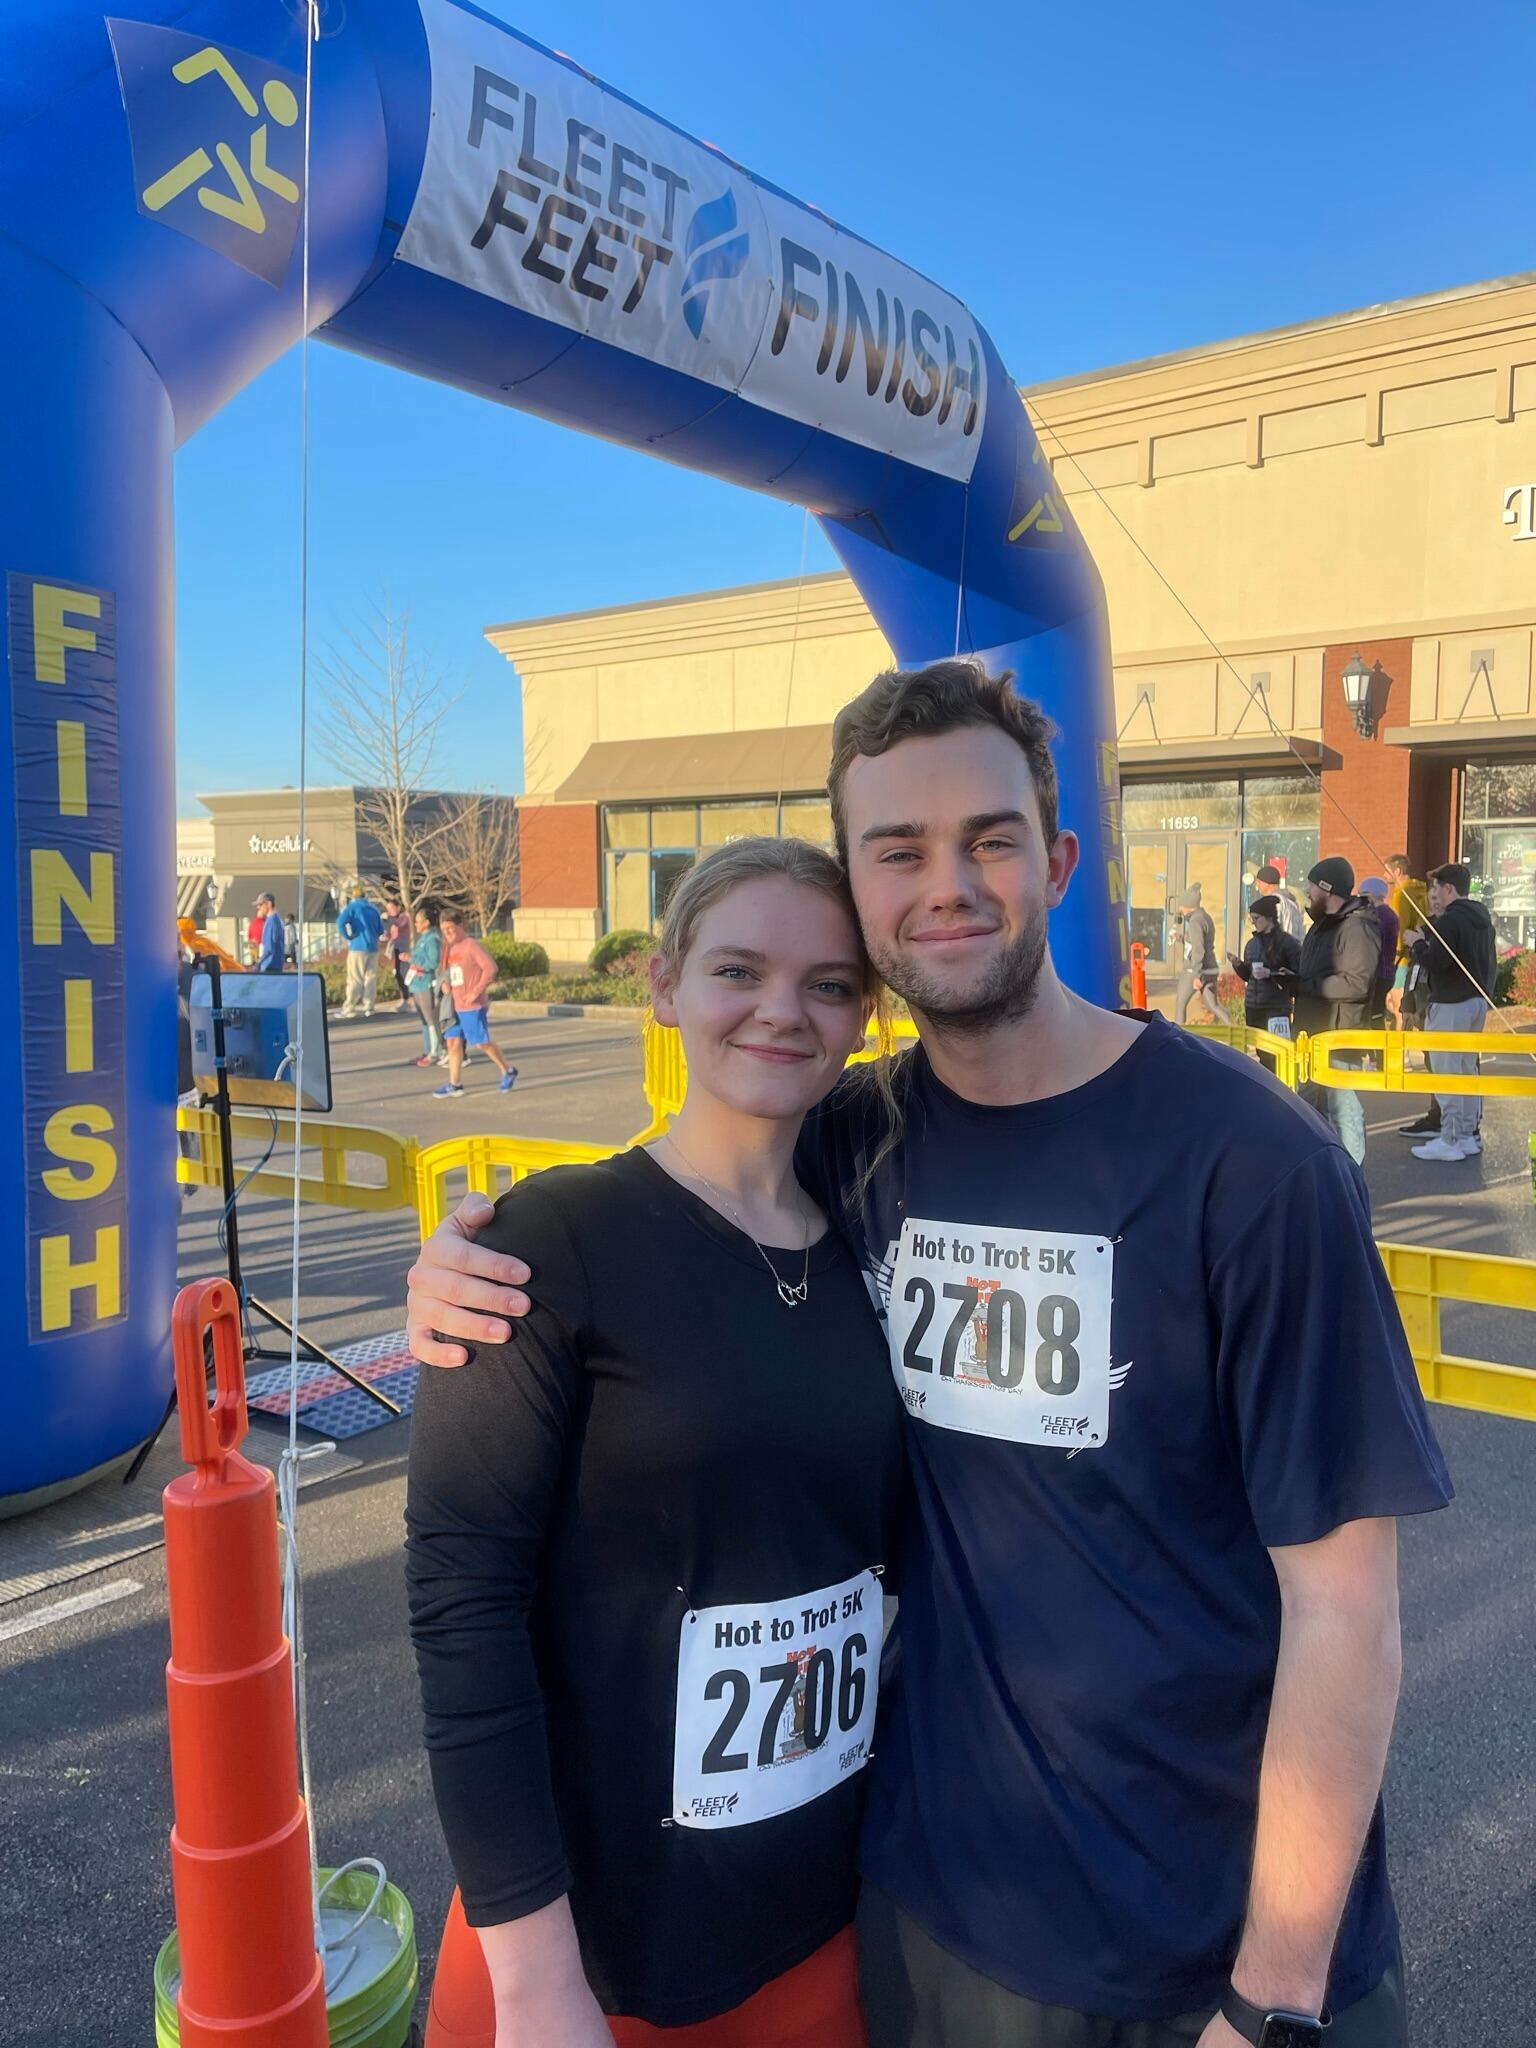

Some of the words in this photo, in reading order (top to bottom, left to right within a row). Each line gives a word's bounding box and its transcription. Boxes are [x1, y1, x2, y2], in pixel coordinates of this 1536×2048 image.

[466, 64, 691, 243] FLEET
[470, 168, 674, 315] FEET
[770, 236, 982, 438] FINISH
[1160, 815, 1199, 830] 11653
[30, 582, 121, 1333] FINISH
[912, 1233, 945, 1260] Hot
[952, 1239, 974, 1264] to
[982, 1241, 1030, 1271] Trot
[1039, 1248, 1076, 1275] 5K
[903, 1276, 1080, 1396] 2708
[1041, 1415, 1078, 1427] FLEET
[1044, 1424, 1075, 1436] FEET
[715, 1620, 762, 1648] Hot
[770, 1618, 795, 1642] to
[801, 1601, 838, 1634] Trot
[842, 1588, 865, 1619] 5K
[701, 1632, 868, 1775] 2706
[691, 1795, 729, 1808] FLEET
[694, 1805, 725, 1817] FEET
